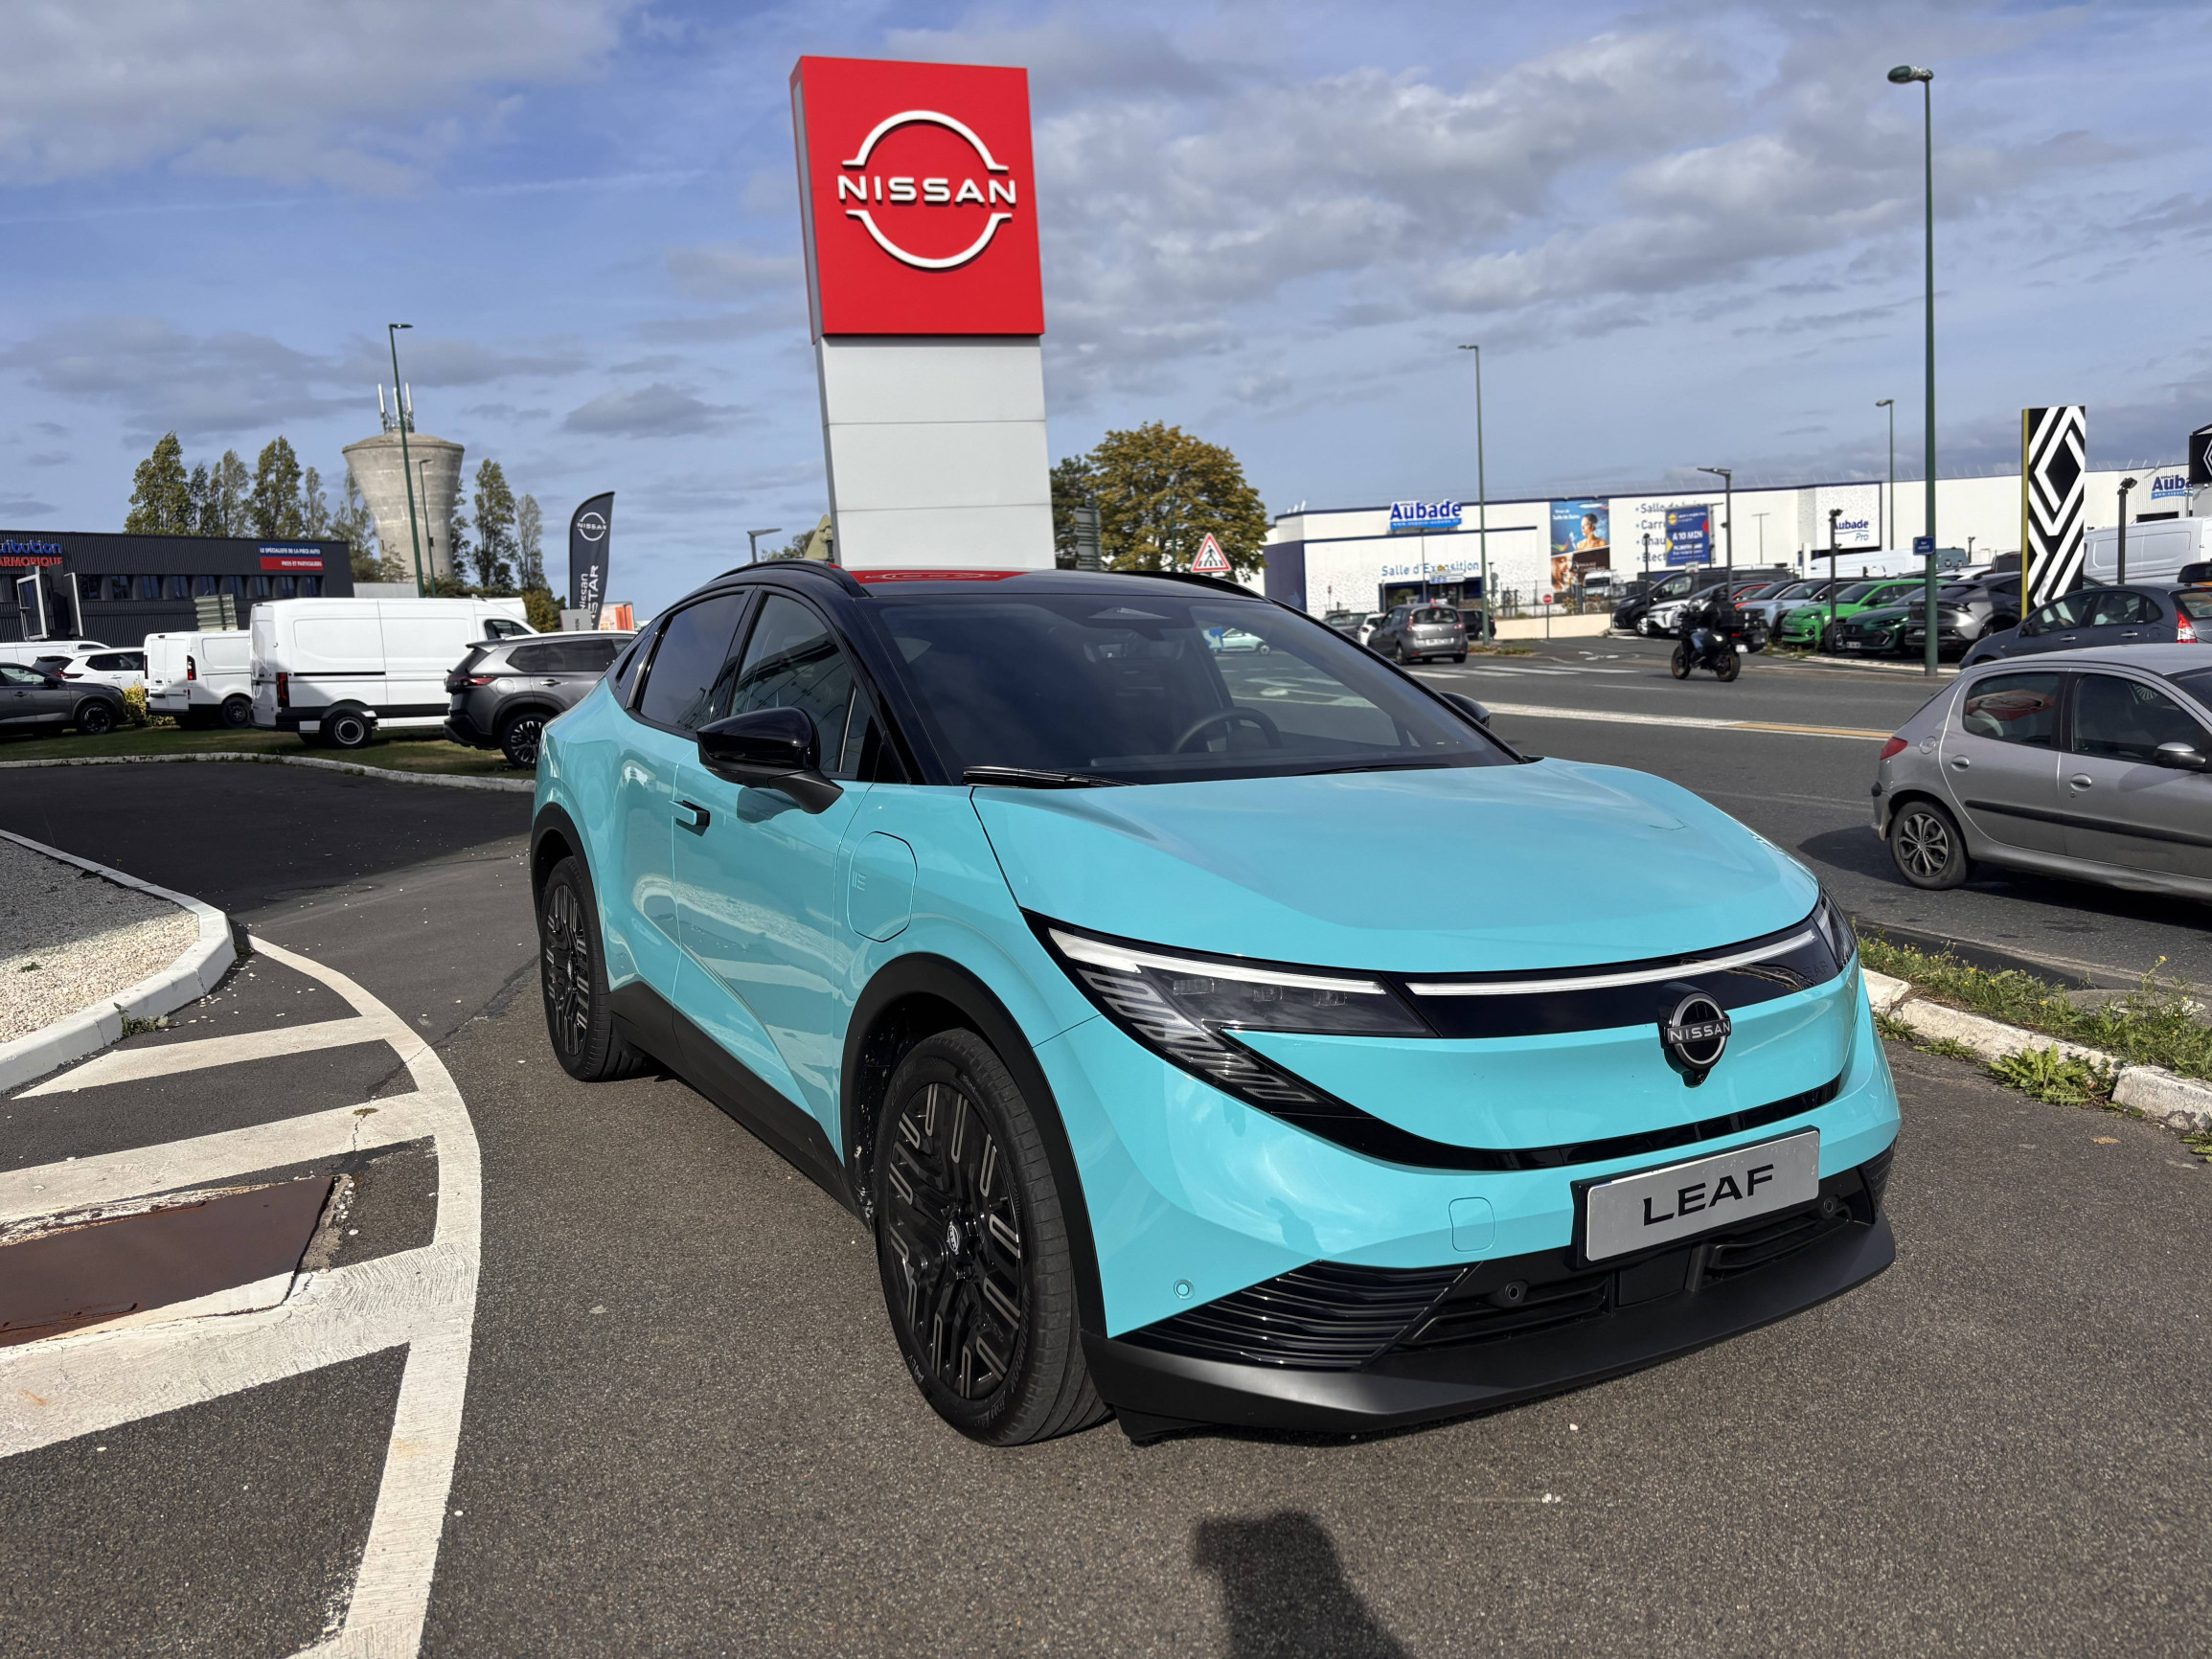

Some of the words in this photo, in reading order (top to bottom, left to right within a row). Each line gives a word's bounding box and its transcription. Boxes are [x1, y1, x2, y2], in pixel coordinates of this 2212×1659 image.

[837, 175, 1016, 204] NISSAN
[1390, 501, 1462, 520] Aubade
[577, 522, 606, 531] NISSAN
[1855, 533, 1869, 542] Pro
[0, 539, 62, 554] ribution
[1381, 565, 1410, 577] Salle
[1670, 1019, 1730, 1042] NISSAN
[1643, 1165, 1774, 1227] LEAF
